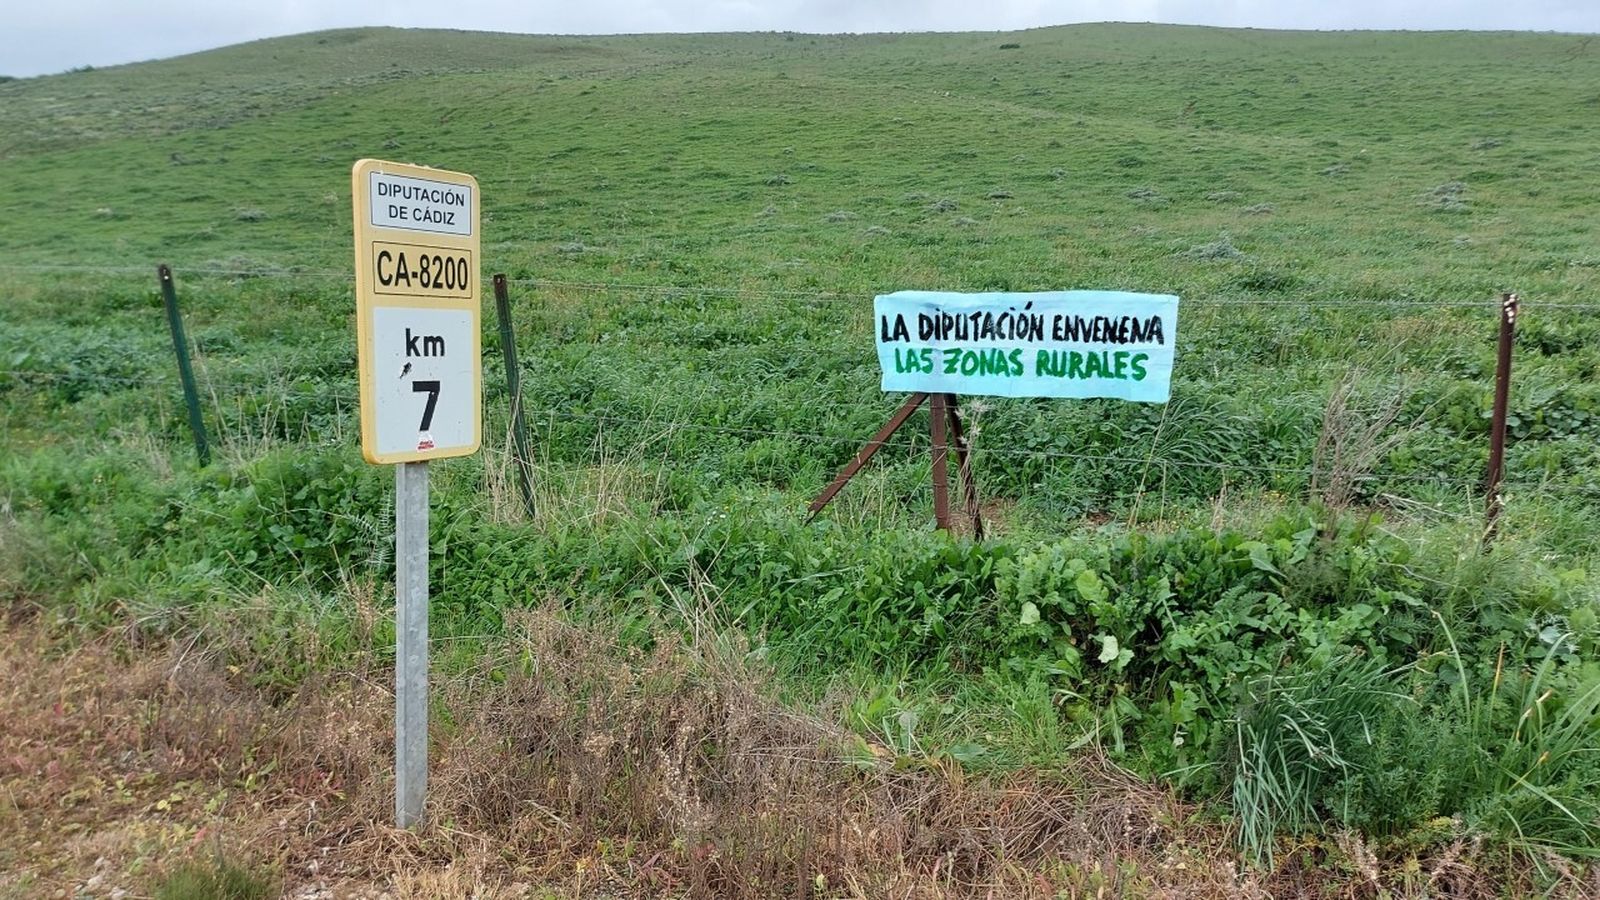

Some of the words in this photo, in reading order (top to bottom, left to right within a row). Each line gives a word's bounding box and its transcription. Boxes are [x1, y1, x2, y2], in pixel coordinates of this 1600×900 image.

[378, 182, 465, 206] DIPUTACIÓN
[389, 205, 408, 219] DE
[413, 206, 455, 225] CÁDIZ
[377, 250, 468, 290] CA-8200
[405, 328, 445, 357] km
[881, 314, 910, 343] LA
[1052, 314, 1165, 345] ENVENENA
[895, 348, 934, 374] LAS
[943, 348, 1024, 377] ZONAS
[1035, 350, 1149, 381] RURALES
[412, 380, 441, 431] 7
